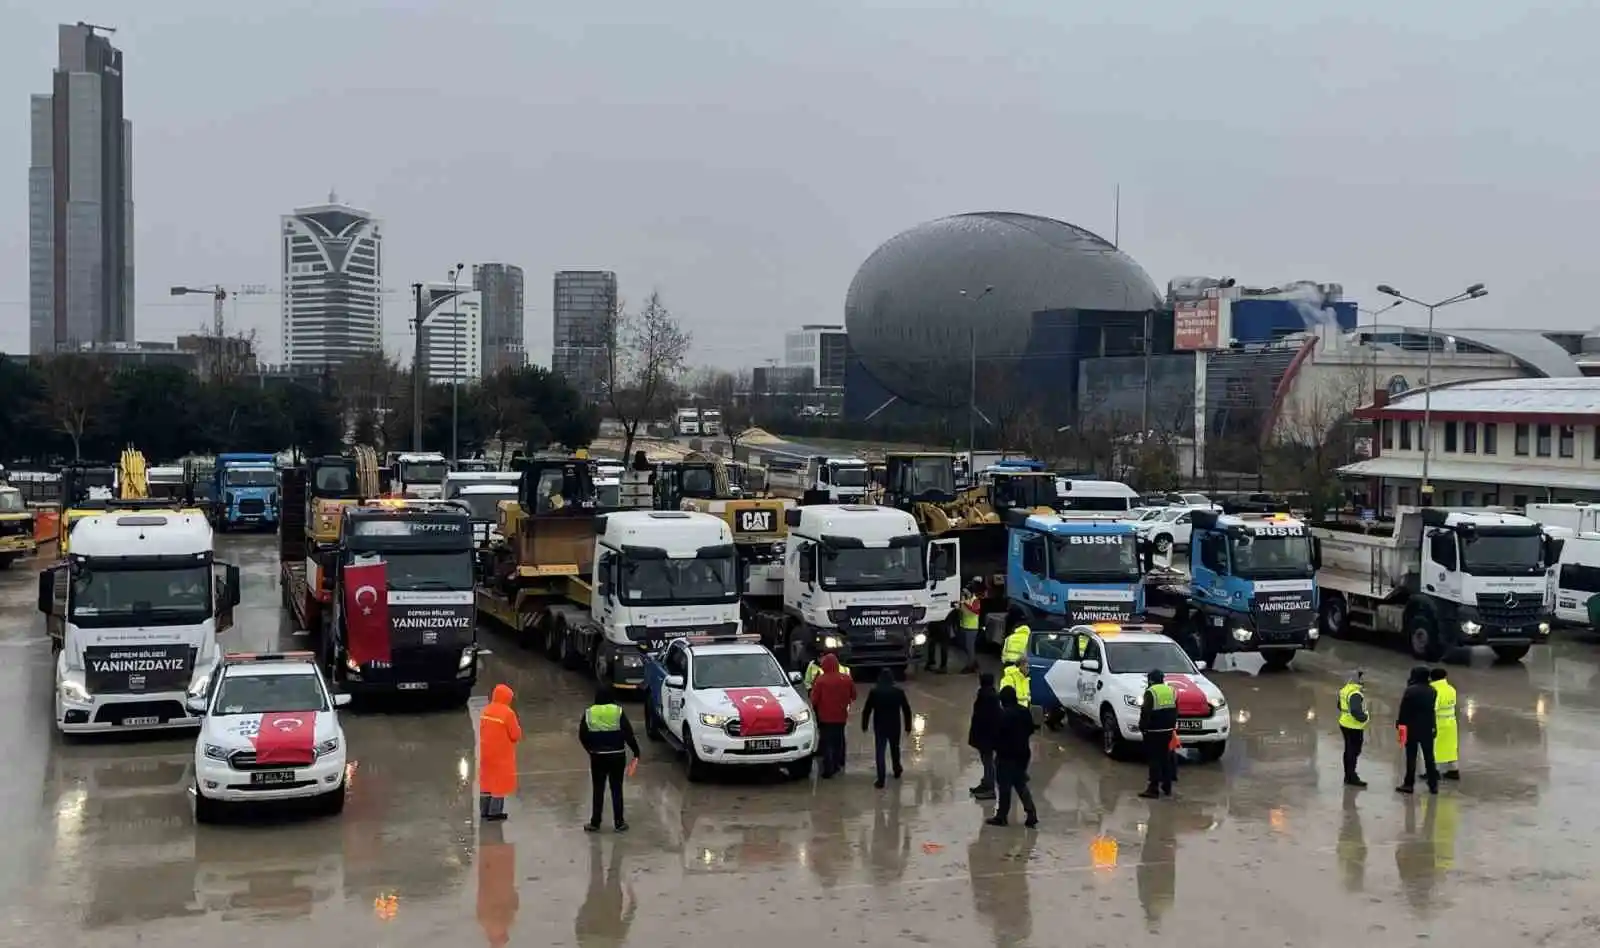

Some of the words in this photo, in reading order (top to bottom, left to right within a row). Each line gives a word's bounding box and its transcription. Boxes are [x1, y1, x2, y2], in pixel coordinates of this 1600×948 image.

[742, 511, 771, 531] CAT
[392, 617, 470, 628] YANINIZDAYIZ
[93, 659, 184, 672] YANINIZDAYIZ
